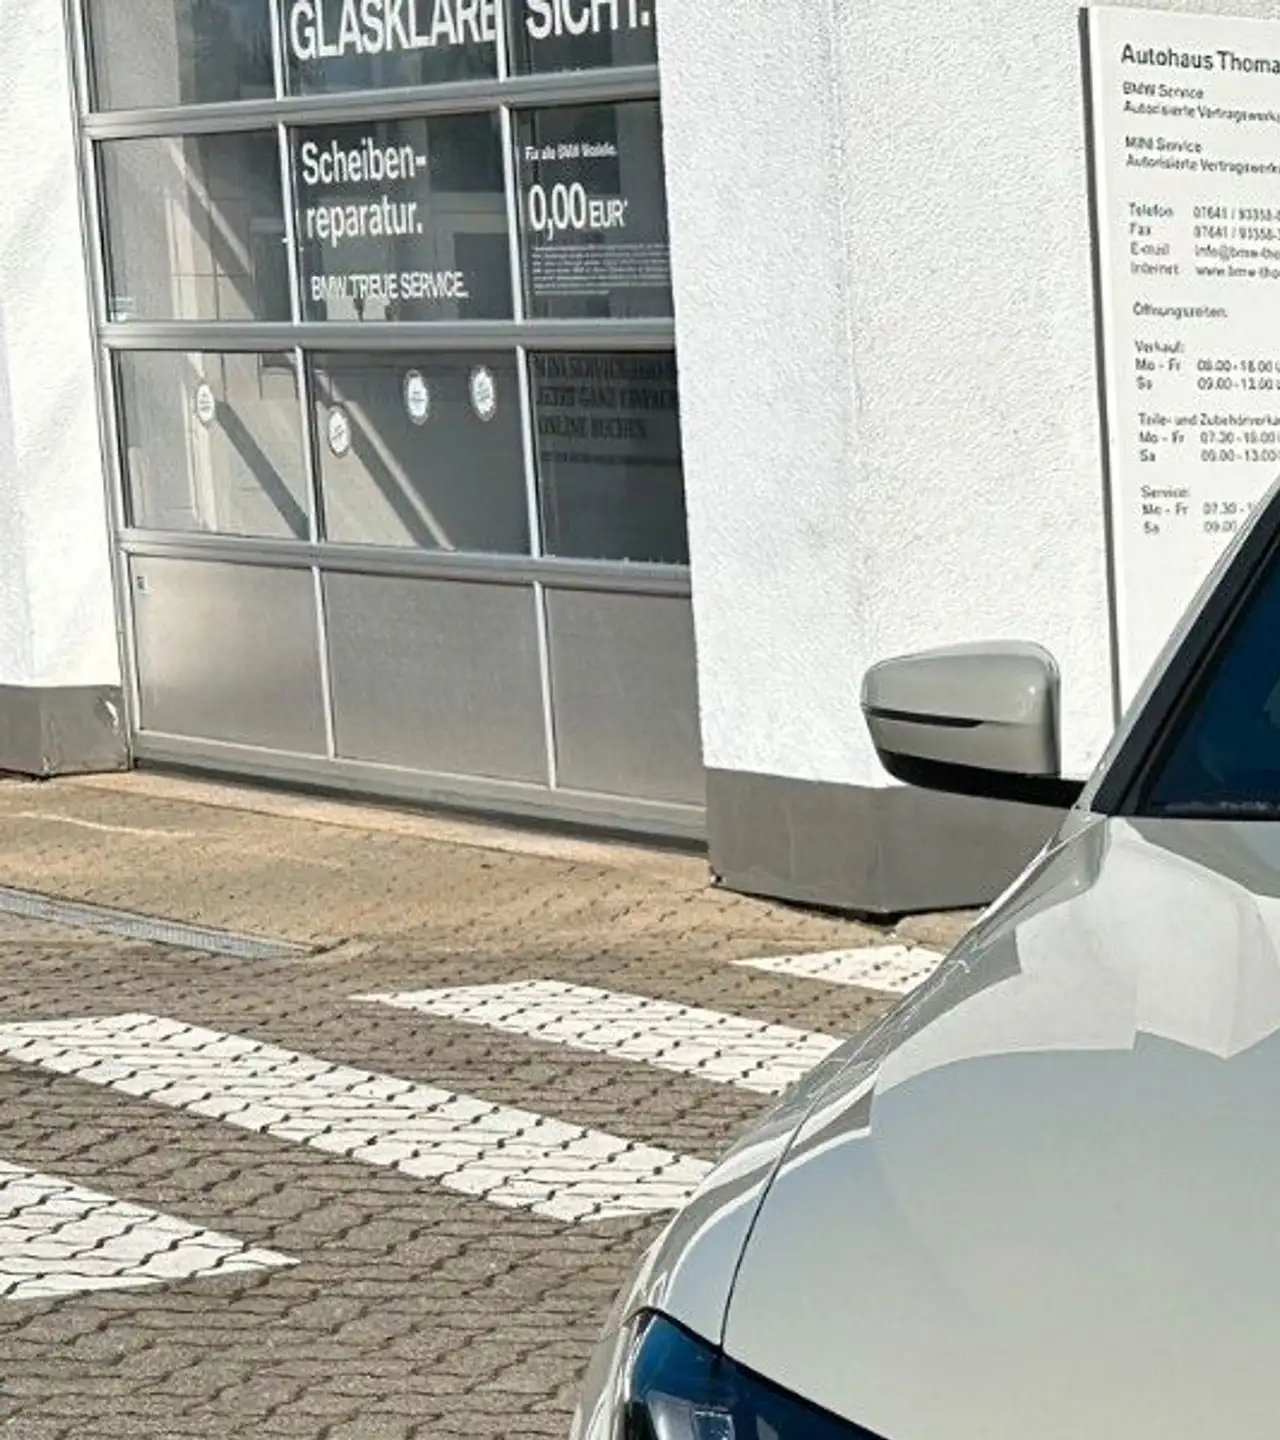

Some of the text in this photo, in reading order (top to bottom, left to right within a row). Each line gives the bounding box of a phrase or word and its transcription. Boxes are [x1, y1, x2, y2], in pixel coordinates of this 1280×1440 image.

[289, 0, 497, 60] GLASKLARE
[1121, 43, 1280, 74] Autohaus Thoma
[1123, 81, 1204, 99] BMW Service
[1156, 136, 1202, 153] Service
[302, 137, 427, 185] Scheiben-
[306, 195, 424, 247] reparatur.
[529, 182, 586, 241] 0,00
[1129, 202, 1174, 218] Telefon
[1129, 222, 1151, 237] Fax
[1130, 261, 1179, 276] Internet
[311, 274, 348, 301] BMW
